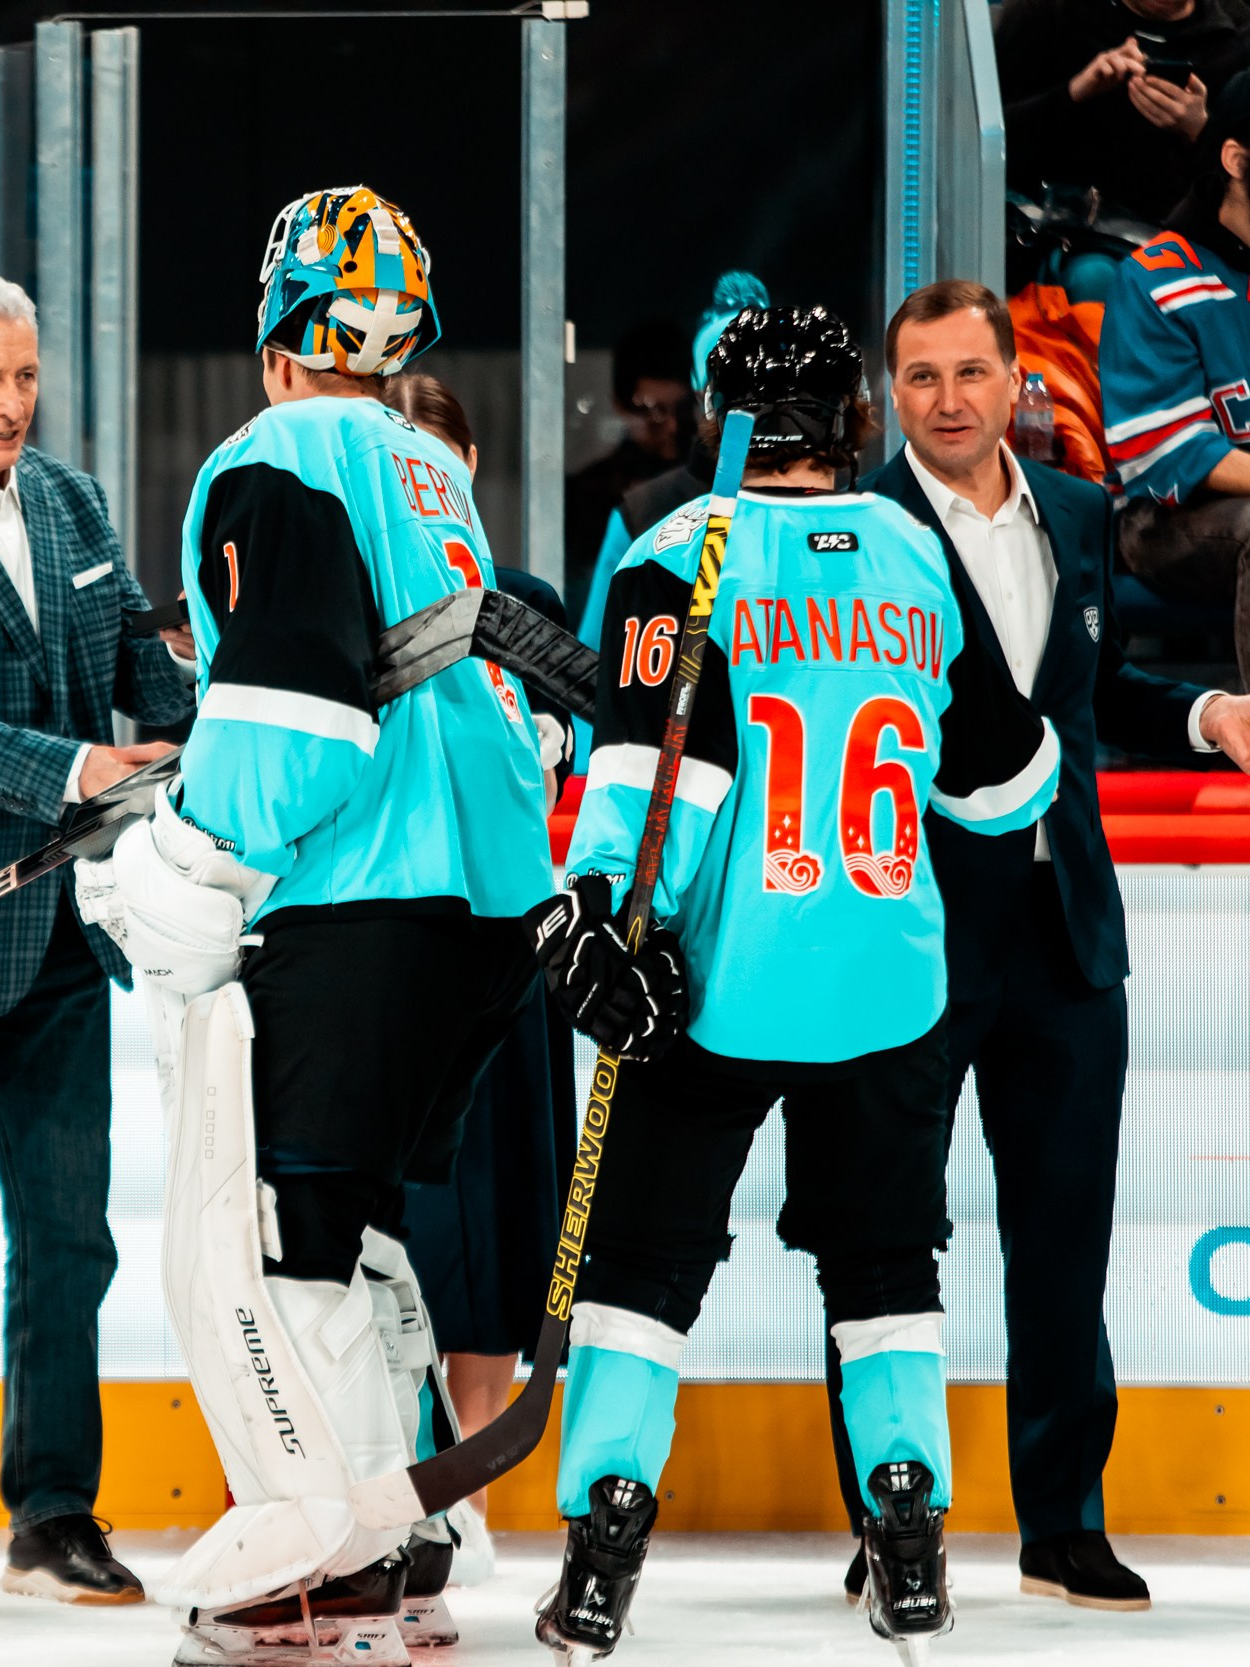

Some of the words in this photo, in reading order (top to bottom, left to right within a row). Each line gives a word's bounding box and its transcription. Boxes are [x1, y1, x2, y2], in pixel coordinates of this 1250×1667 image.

[223, 541, 240, 613] 1
[619, 614, 679, 689] 16
[731, 597, 945, 682] ATANASOV
[748, 694, 929, 900] 16
[547, 1046, 621, 1322] SHERWOO
[235, 1308, 307, 1460] SUPREME
